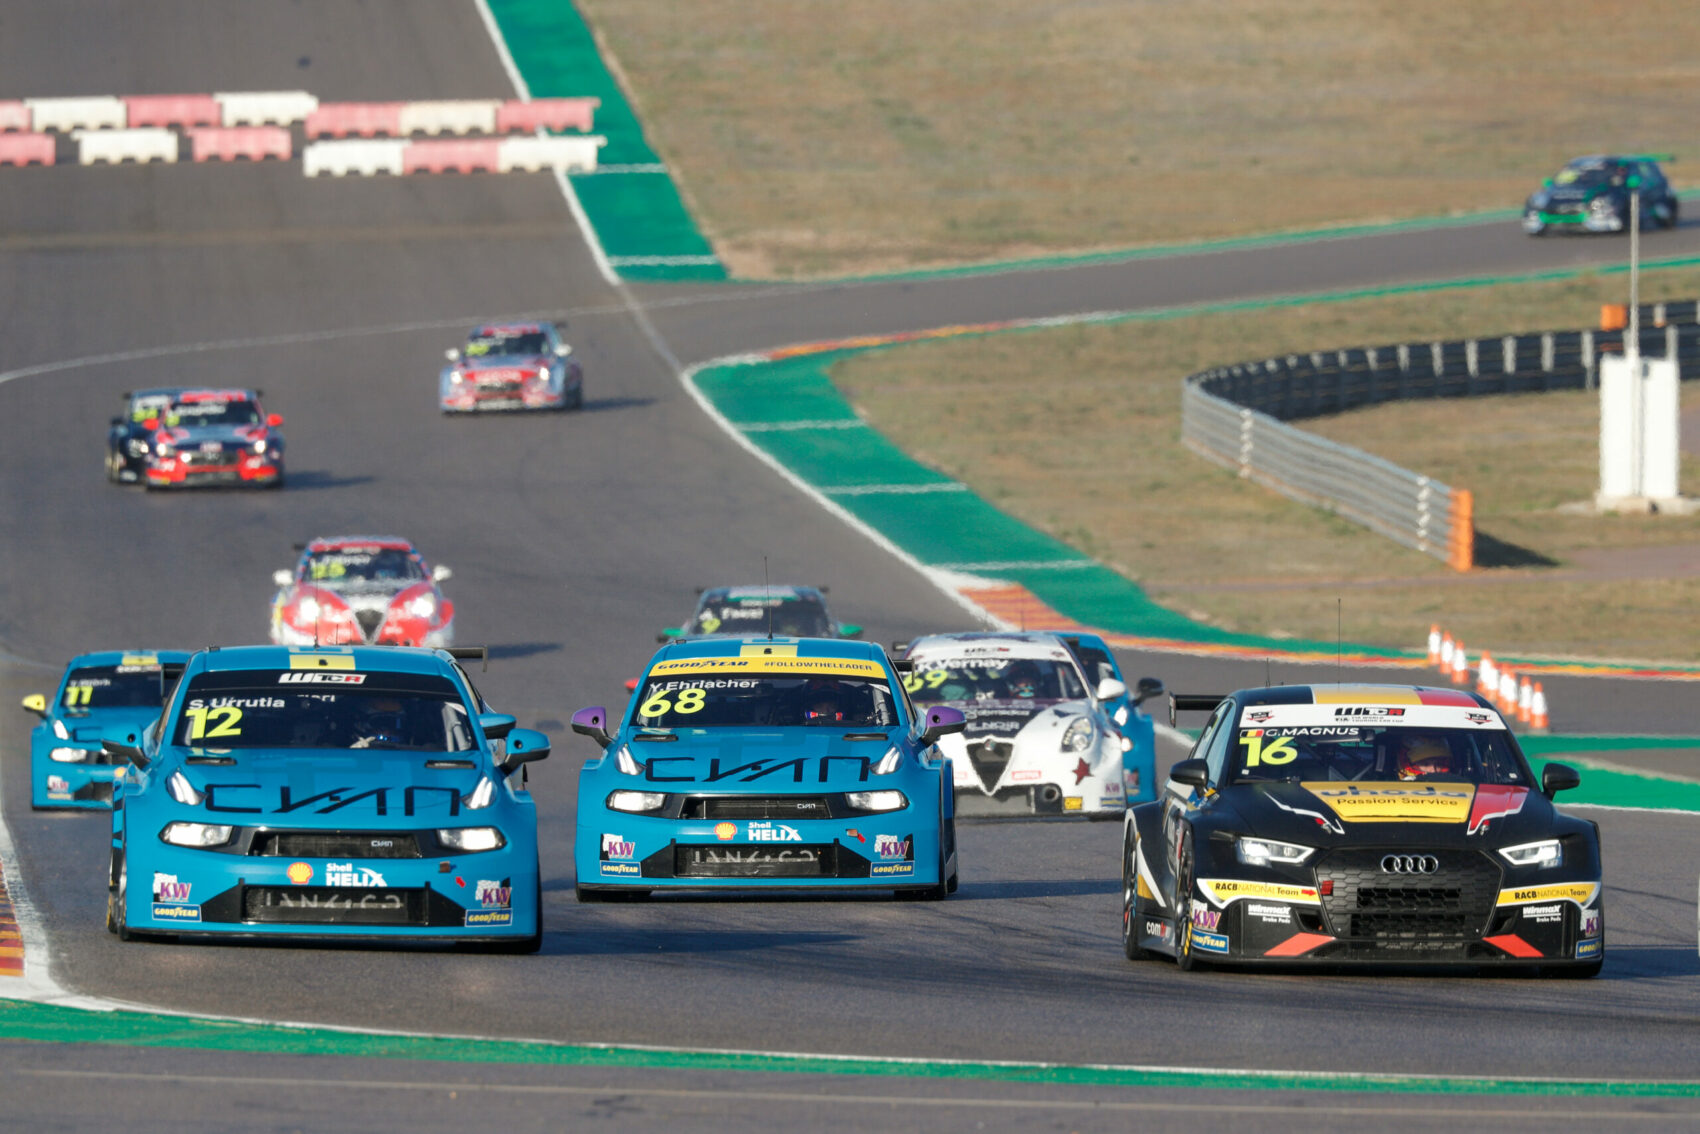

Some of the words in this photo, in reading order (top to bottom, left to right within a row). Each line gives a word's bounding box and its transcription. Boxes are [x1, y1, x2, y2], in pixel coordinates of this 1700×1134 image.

[658, 660, 748, 669] GOODYEAR
[764, 661, 872, 670] #FOLLOWTHELEADER
[278, 673, 367, 684] WTCR
[902, 669, 949, 694] 69
[650, 680, 759, 692] Y.Ehrlacher
[65, 686, 93, 706] 11
[640, 688, 707, 717] 68
[189, 697, 286, 710] S.Urrutia
[1335, 707, 1405, 716] WTCR
[185, 707, 243, 740] 12
[1265, 727, 1360, 738] G.MAGNUS
[1239, 737, 1298, 767] 16
[646, 756, 871, 782] CYAN
[205, 784, 461, 817] CYAN
[1337, 797, 1396, 805] Passion
[1401, 797, 1458, 805] Service
[748, 825, 802, 841] HELIX
[608, 841, 635, 856] KW
[881, 840, 910, 856] KW
[325, 863, 352, 872] Shell
[602, 864, 639, 874] GOODYEAR
[873, 864, 912, 874] GOODYEAR
[325, 867, 388, 887] HELIX
[159, 882, 192, 899] KW
[482, 886, 512, 905] KW
[1215, 883, 1238, 891] RACB
[1277, 887, 1299, 896] Team
[1514, 890, 1537, 900] RACB
[1570, 888, 1587, 896] Team
[154, 907, 198, 918] GOODYEAR
[468, 911, 510, 923] GOODYEAR
[1193, 909, 1221, 928] KW
